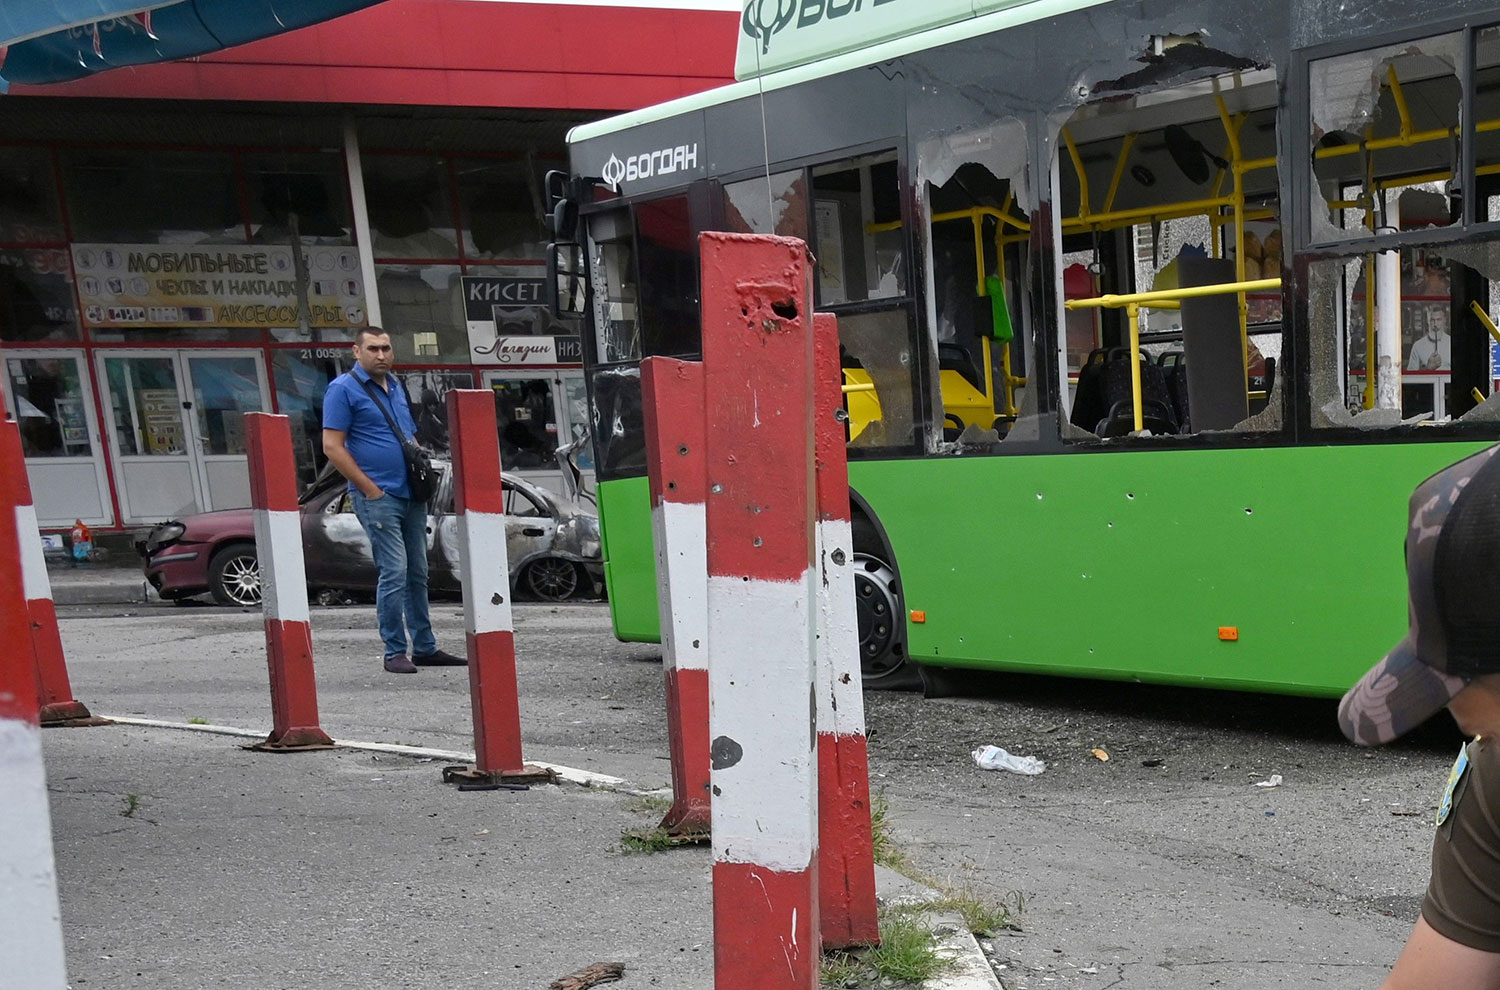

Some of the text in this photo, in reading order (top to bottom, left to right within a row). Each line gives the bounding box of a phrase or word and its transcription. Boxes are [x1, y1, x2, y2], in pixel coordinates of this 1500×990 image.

[625, 143, 698, 182] БОГДАН
[127, 252, 269, 275] МОБИЛЬНЫЕ
[156, 279, 210, 297] ЧЕХЛЫ
[212, 279, 226, 296] И
[470, 282, 544, 301] КИСЕТ
[474, 338, 551, 363] Магазин
